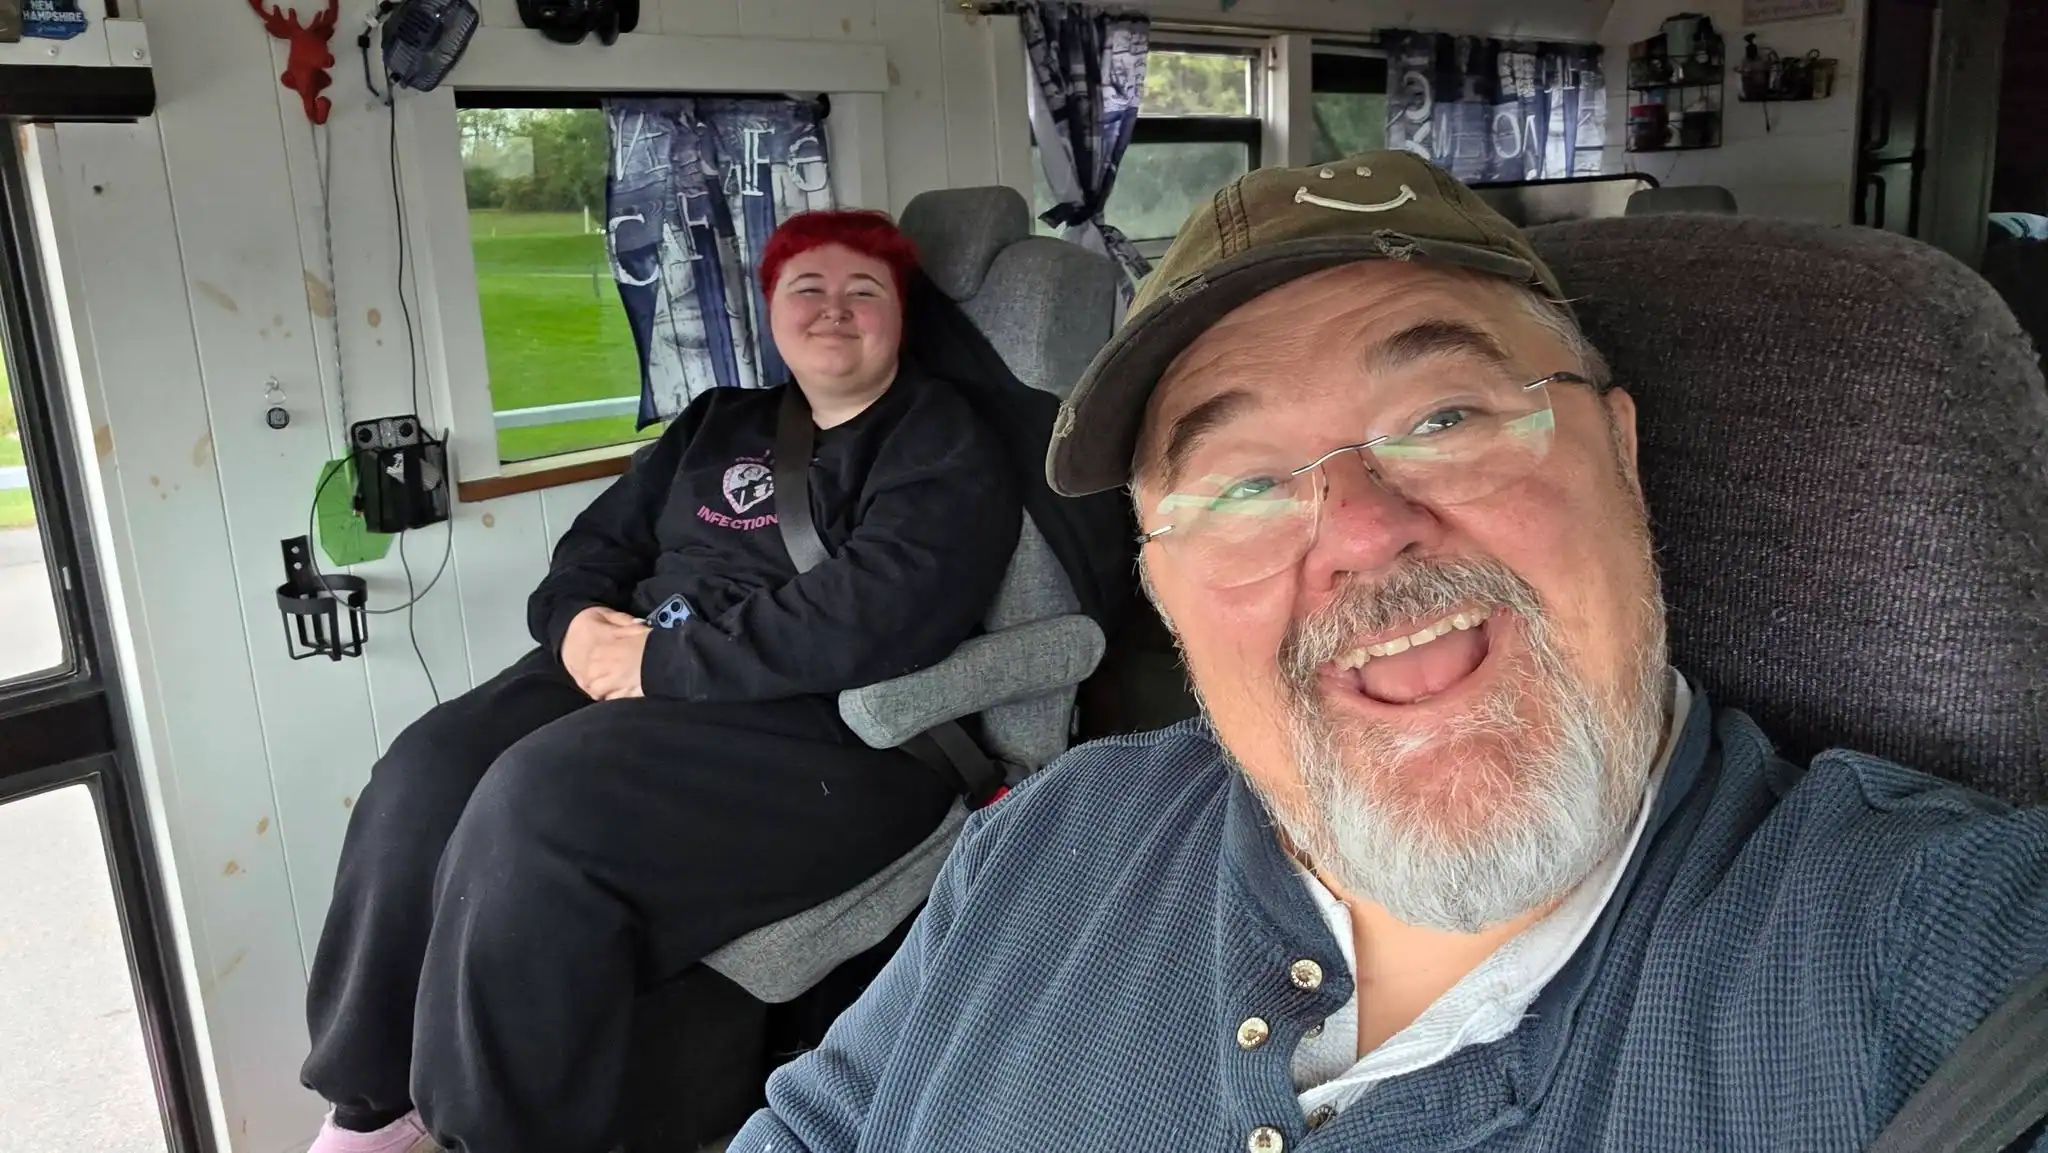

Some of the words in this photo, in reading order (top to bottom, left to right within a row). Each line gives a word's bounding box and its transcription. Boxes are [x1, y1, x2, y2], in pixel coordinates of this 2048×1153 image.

[30, 0, 54, 10] NEW
[23, 11, 83, 21] HAMPSHIRE
[697, 504, 779, 531] INFECTION
